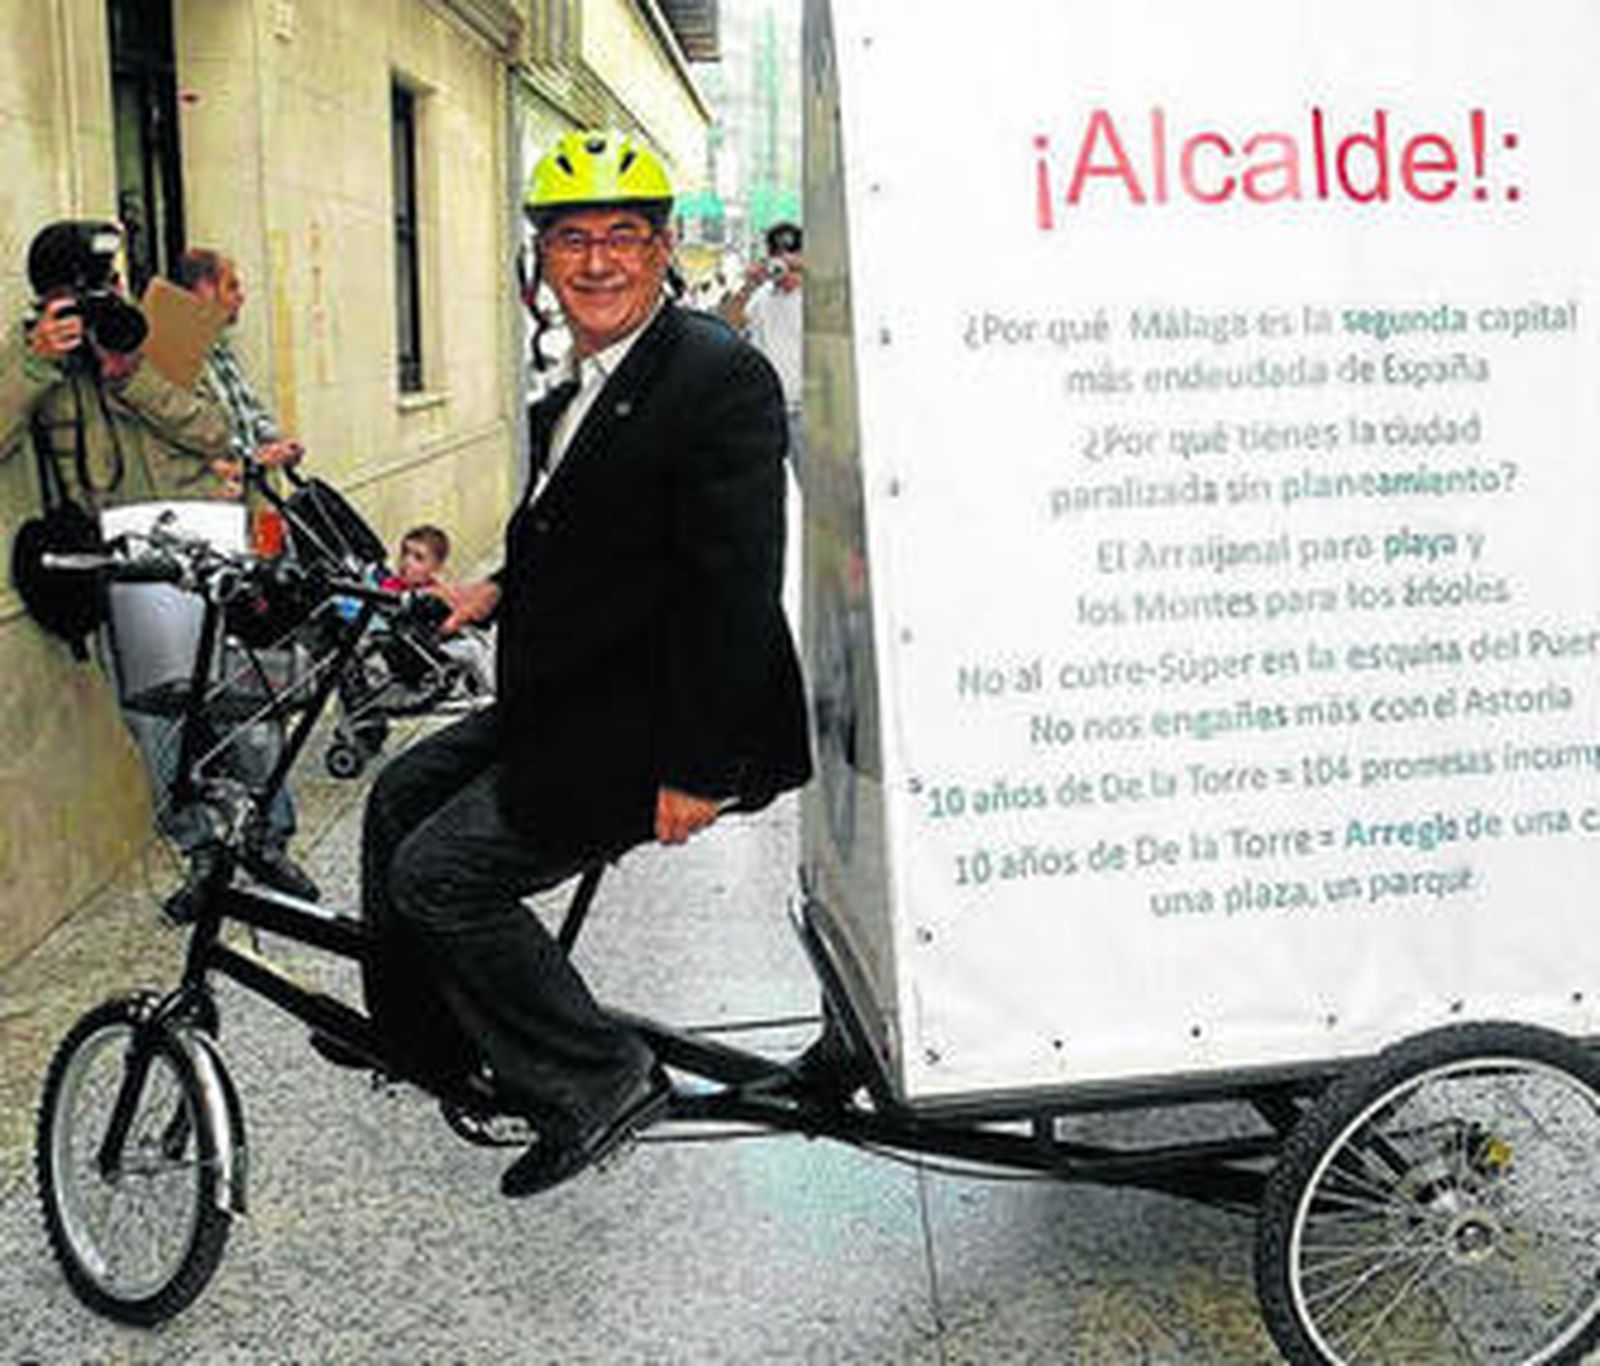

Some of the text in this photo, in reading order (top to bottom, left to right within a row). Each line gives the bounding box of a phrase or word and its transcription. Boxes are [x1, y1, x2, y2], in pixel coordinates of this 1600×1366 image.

[1034, 107, 1520, 231] ¡Alcalde!:
[963, 311, 1037, 349] ¿Por
[1048, 307, 1109, 348] qué
[1130, 308, 1248, 345] Málaga
[1303, 305, 1332, 337] la
[1341, 304, 1468, 340] segunda
[1478, 302, 1578, 338] capital
[1068, 351, 1489, 394] más endeudada de España
[1082, 411, 1482, 462] ¿Por qué tienes la ciudad
[1051, 462, 1519, 517] paralizada sin planeamiento?
[1097, 526, 1485, 574] El Arraijanal para playa y
[1077, 572, 1510, 626] los Montes para los árboles
[957, 664, 1004, 696] No
[1015, 659, 1041, 692] al
[1059, 650, 1254, 690] cutre-Súper
[1262, 646, 1299, 675] en
[1308, 640, 1335, 671] la
[1346, 634, 1461, 673] esquina
[1469, 629, 1519, 662] del
[1030, 715, 1075, 745] No
[1083, 714, 1142, 741] nos
[1152, 699, 1287, 741] engañes
[1369, 695, 1428, 723] con
[1434, 687, 1456, 719] el
[1465, 684, 1573, 718] Astoria
[929, 784, 965, 817] 10
[973, 781, 1047, 815] años
[1057, 772, 1095, 807] de
[1101, 771, 1145, 803] De
[1150, 768, 1176, 797] la
[1187, 762, 1267, 795] Torre
[1277, 768, 1292, 784] =
[1361, 748, 1494, 787] promesas
[955, 848, 991, 885] 10
[1000, 846, 1078, 879] años
[1087, 840, 1126, 872] de
[1135, 834, 1180, 867] De
[1190, 831, 1219, 861] la
[1229, 826, 1313, 859] Torre
[1320, 828, 1333, 845] =
[1465, 808, 1502, 840] de
[1513, 809, 1571, 836] una
[1150, 889, 1214, 918] una
[1224, 877, 1317, 917] plaza,
[1324, 874, 1362, 902] un
